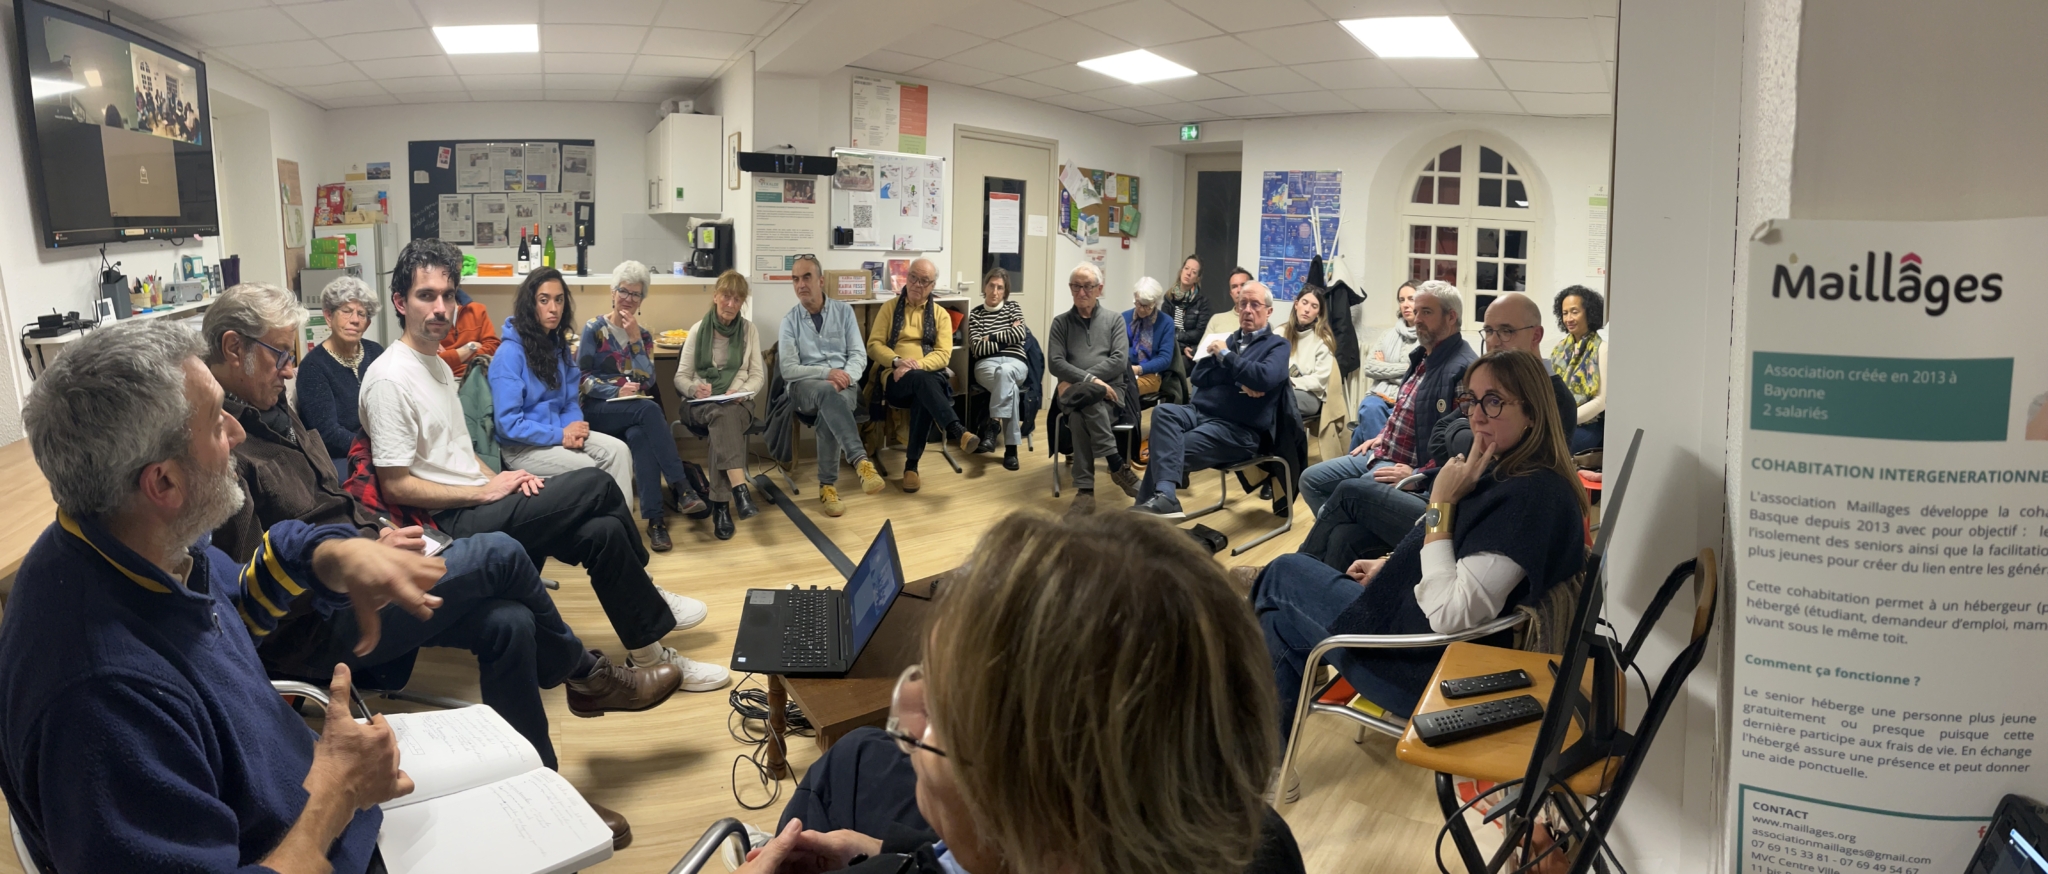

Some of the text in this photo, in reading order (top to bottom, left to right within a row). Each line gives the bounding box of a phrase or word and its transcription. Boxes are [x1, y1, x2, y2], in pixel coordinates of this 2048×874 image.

[1772, 251, 2003, 317] Maillâges
[1764, 363, 1957, 384] Association créée en 2013 à
[1763, 383, 1825, 401] Bayonne
[1762, 403, 1828, 420] 2 salariés
[1751, 457, 1874, 479] COHABITATION
[1749, 508, 1798, 526] Basque
[1805, 514, 1850, 530] depuis
[1857, 520, 1890, 534] 2013
[1896, 525, 1926, 536] avec
[1932, 527, 1963, 539] pour
[1969, 525, 2017, 539] objectif
[1846, 500, 1910, 517] Maillages
[1921, 505, 1988, 519] développe
[1998, 506, 2009, 518] la
[1748, 546, 2048, 578] plus jeunes pour créer du lien entre les génér
[1825, 537, 1849, 549] des
[1854, 540, 1903, 554] seniors
[1909, 543, 1938, 556] ainsi
[1943, 546, 1968, 557] que
[1972, 546, 1983, 556] la
[1747, 580, 1781, 594] Cette
[1786, 584, 1870, 605] cohabitation
[1875, 595, 1923, 609] permet
[1929, 599, 1937, 612] à
[1942, 600, 1959, 612] un
[1964, 600, 2031, 614] hébergeur
[1747, 597, 1800, 616] hébergé
[1804, 605, 1868, 625] (étudiant,
[1871, 613, 1947, 629] demandeur
[1745, 615, 1908, 644] vivant sous le même toit.
[1745, 654, 1812, 674] Comment
[1816, 666, 1830, 678] ça
[1834, 665, 1910, 686] fonctionne
[1744, 685, 2037, 726] Le senior héberge une personne plus jeune
[1743, 702, 2034, 742] gratuitement ou presque puisque cette
[1743, 717, 2032, 759] dernière participe aux frais de vie. En échange
[1742, 749, 1868, 779] une aide ponctuelle.
[1803, 742, 1846, 759] assure
[1849, 752, 1874, 763] une
[1877, 756, 1935, 770] présence
[1938, 760, 1951, 771] et
[1954, 761, 1982, 774] peut
[1986, 761, 2030, 773] donner
[1752, 801, 1809, 820] CONTACT
[1752, 814, 1857, 844] www.maillages.org
[1751, 827, 1932, 865] associationmaillages@gmail.com
[1751, 839, 1765, 849] 07
[1768, 843, 1782, 853] 69
[1785, 846, 1798, 856] 15
[1801, 849, 1815, 859] 33
[1816, 852, 1830, 862] 81
[1839, 856, 1853, 867] 07
[1857, 860, 1870, 870] 69
[1873, 863, 1887, 872] 49
[1889, 865, 1903, 874] 54
[1905, 866, 1919, 874] 67
[1751, 851, 1841, 874] MVC Centre Ville
[1751, 863, 1764, 874] 11
